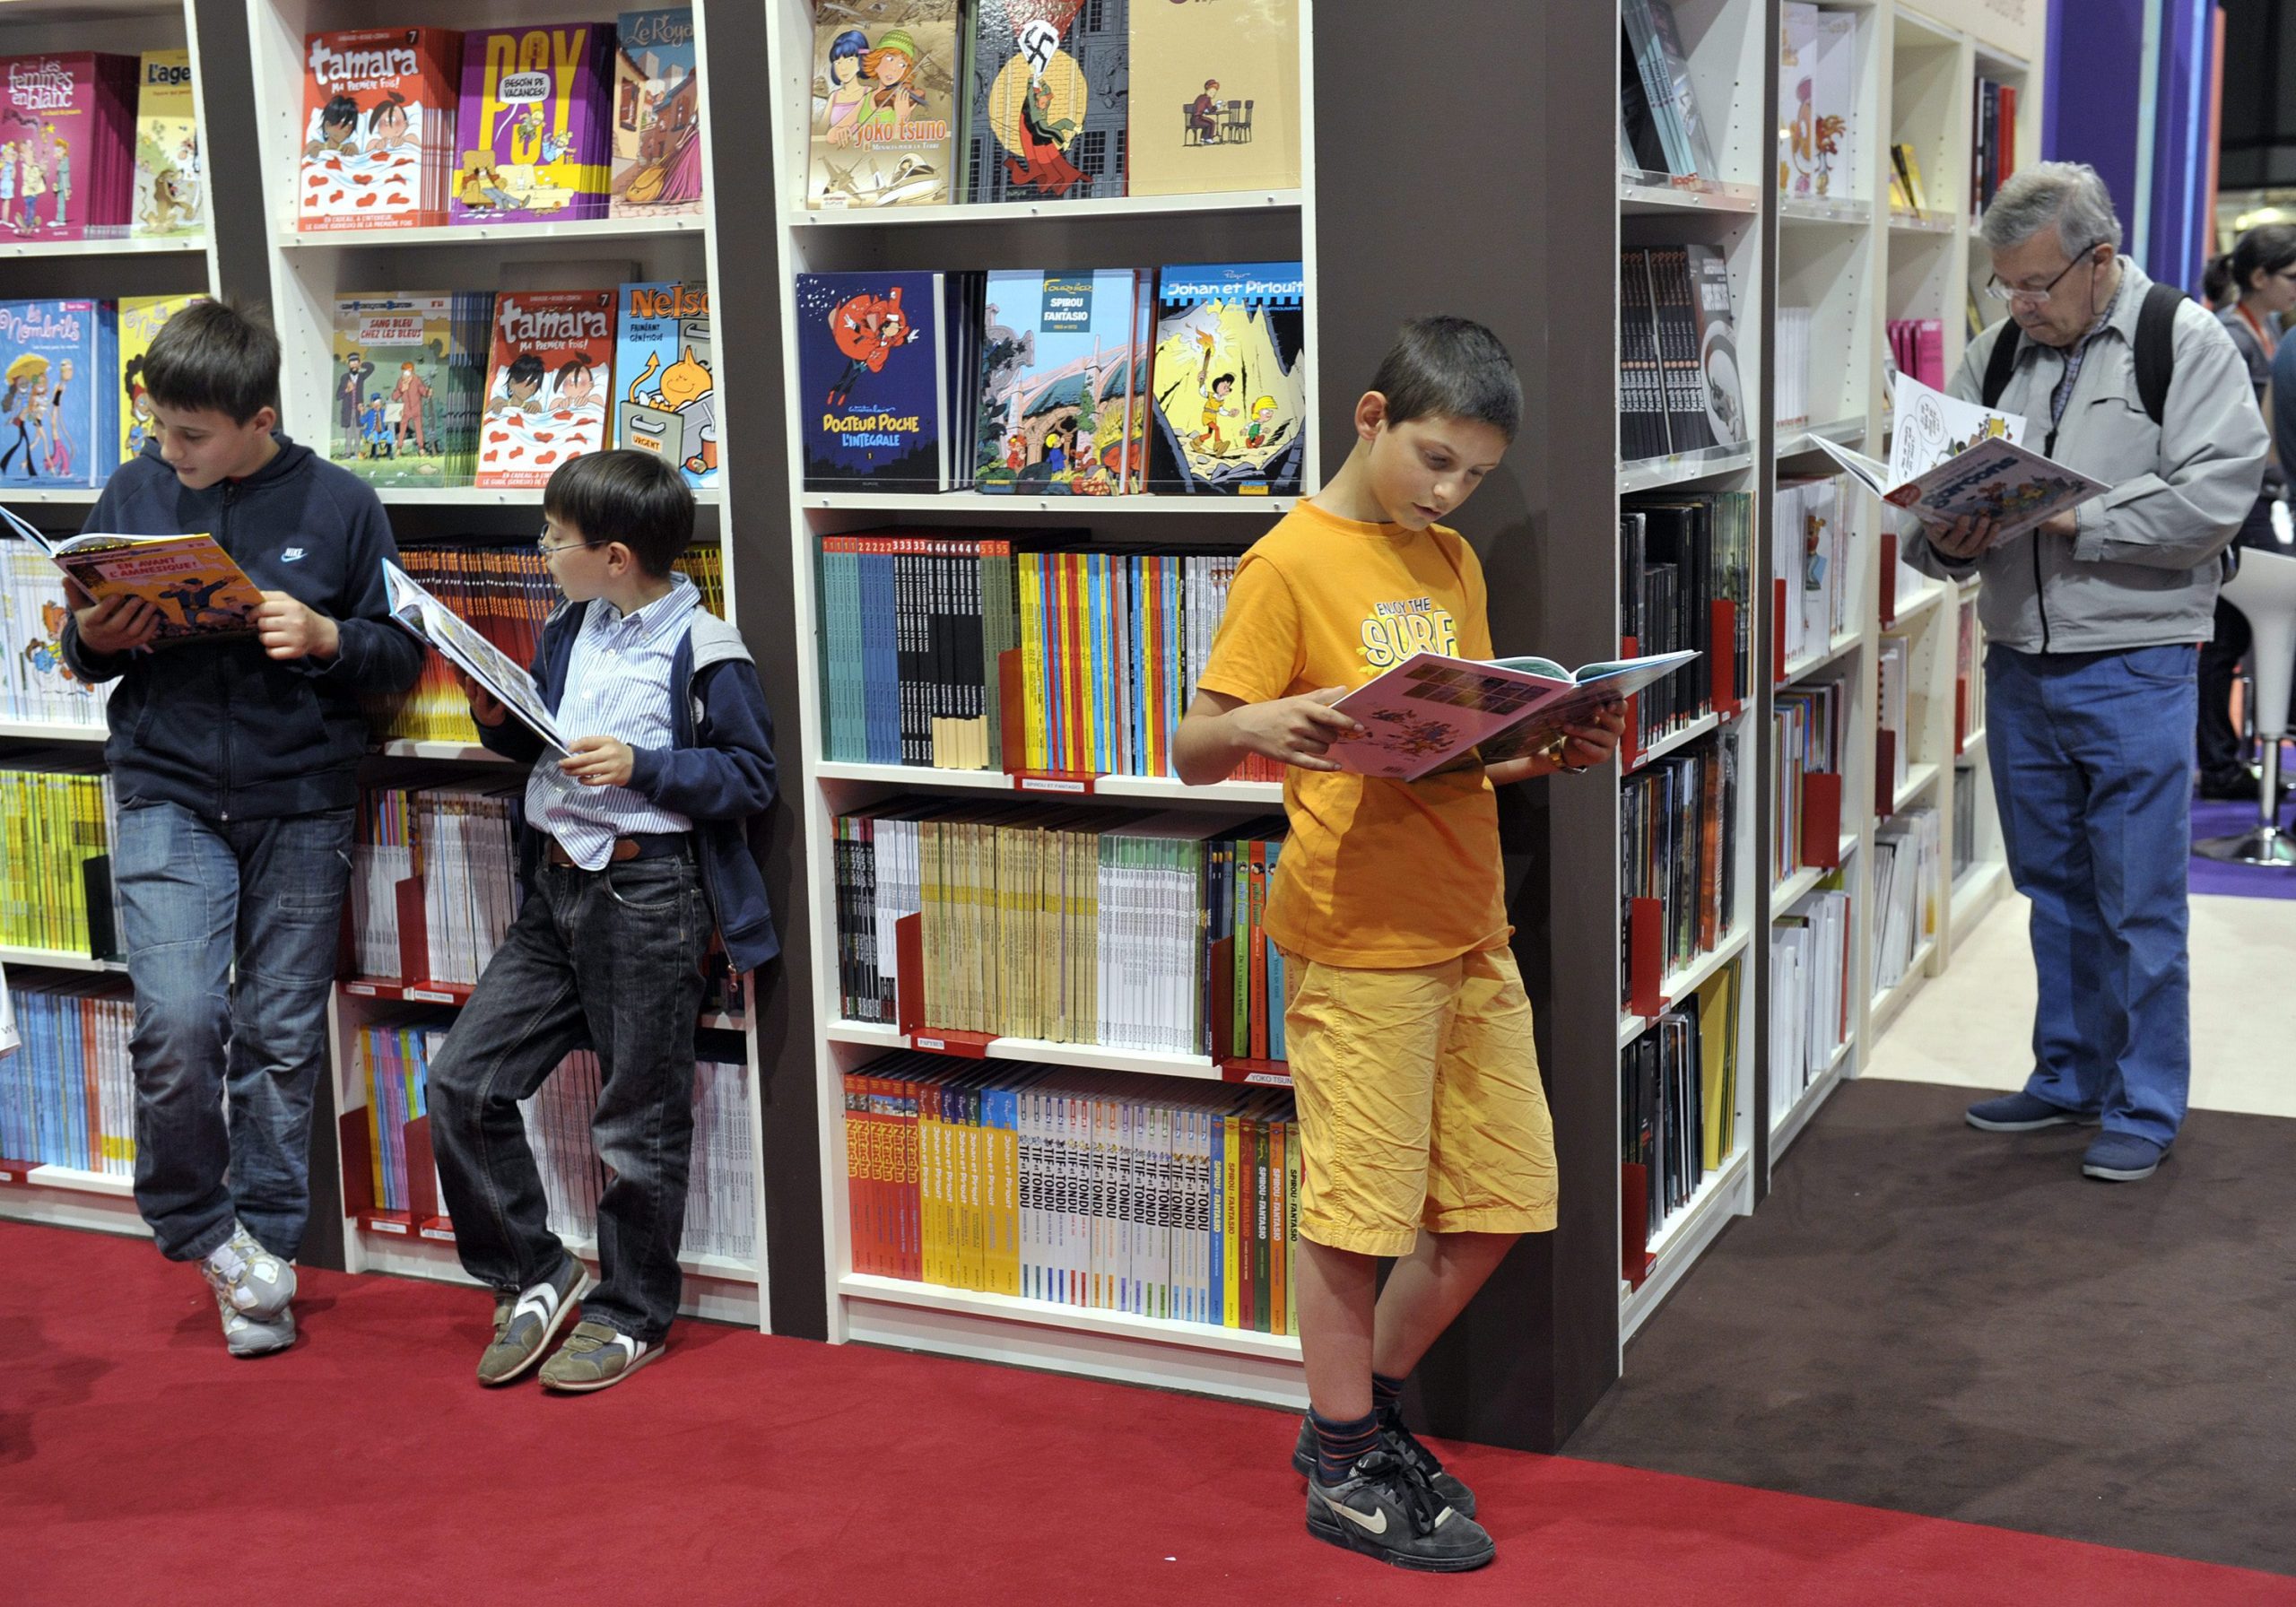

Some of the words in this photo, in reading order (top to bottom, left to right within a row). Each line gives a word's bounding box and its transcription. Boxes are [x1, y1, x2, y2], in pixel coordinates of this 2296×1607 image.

[408, 30, 417, 43] 7
[39, 57, 60, 74] Les
[309, 38, 419, 85] tamara
[8, 63, 74, 93] femmes
[535, 77, 544, 86] DE
[27, 87, 73, 109] blanc
[855, 117, 892, 147] yoko
[900, 117, 946, 141] tsuno
[601, 294, 609, 306] 7
[1050, 298, 1083, 308] SPIROU
[1168, 282, 1220, 296] Johan
[1222, 283, 1243, 294] et
[1246, 281, 1303, 294] Pirlouit
[370, 319, 390, 328] SANG
[393, 318, 413, 328] BLEU
[500, 297, 608, 343] tamara
[1044, 311, 1088, 321] FANTASIO
[361, 330, 380, 339] CHEZ
[382, 329, 396, 338] LES
[397, 328, 422, 338] BLEUS
[823, 413, 876, 432] DOCTEUR
[878, 413, 919, 432] POCHE
[632, 435, 661, 451] URGENT
[139, 557, 176, 568] AVANT
[285, 547, 304, 557] NIKE
[1376, 601, 1406, 616] ENJOY
[1408, 597, 1431, 613] THE
[1361, 610, 1455, 667] SURF
[1251, 1074, 1272, 1082] YOKO
[847, 1119, 858, 1177] Natacha
[857, 1120, 871, 1178] Natacha
[871, 1121, 883, 1179] Natacha
[882, 1123, 894, 1181] Natacha
[893, 1124, 907, 1183] Natacha
[907, 1125, 918, 1184] Natacha
[1019, 1145, 1029, 1162] TIF
[1044, 1149, 1054, 1165] TIF
[1067, 1151, 1077, 1168] TIF
[1093, 1154, 1103, 1171] TIF
[1119, 1157, 1130, 1175] TIF
[1135, 1160, 1145, 1177] TIF
[1159, 1163, 1170, 1181] TIF
[1199, 1167, 1209, 1185] TIF
[1213, 1160, 1222, 1189] SPIROU
[1242, 1165, 1250, 1194] SPIROU
[1019, 1170, 1030, 1208] TONDU
[1044, 1173, 1054, 1212] TONDU
[1067, 1176, 1077, 1213] TONDU
[1258, 1167, 1266, 1195] SPIROU
[1273, 1168, 1281, 1197] SPIROU
[1092, 1179, 1103, 1217] TONDU
[1119, 1183, 1130, 1221] TONDU
[1134, 1186, 1144, 1223] TONDU
[1158, 1189, 1170, 1228] TONDU
[1198, 1193, 1209, 1231] TONDU
[1213, 1194, 1222, 1233] FANTASIO
[1242, 1198, 1250, 1238] FANTASIO
[1258, 1199, 1266, 1240] FANTASIO
[1273, 1201, 1282, 1241] FANTASIO
